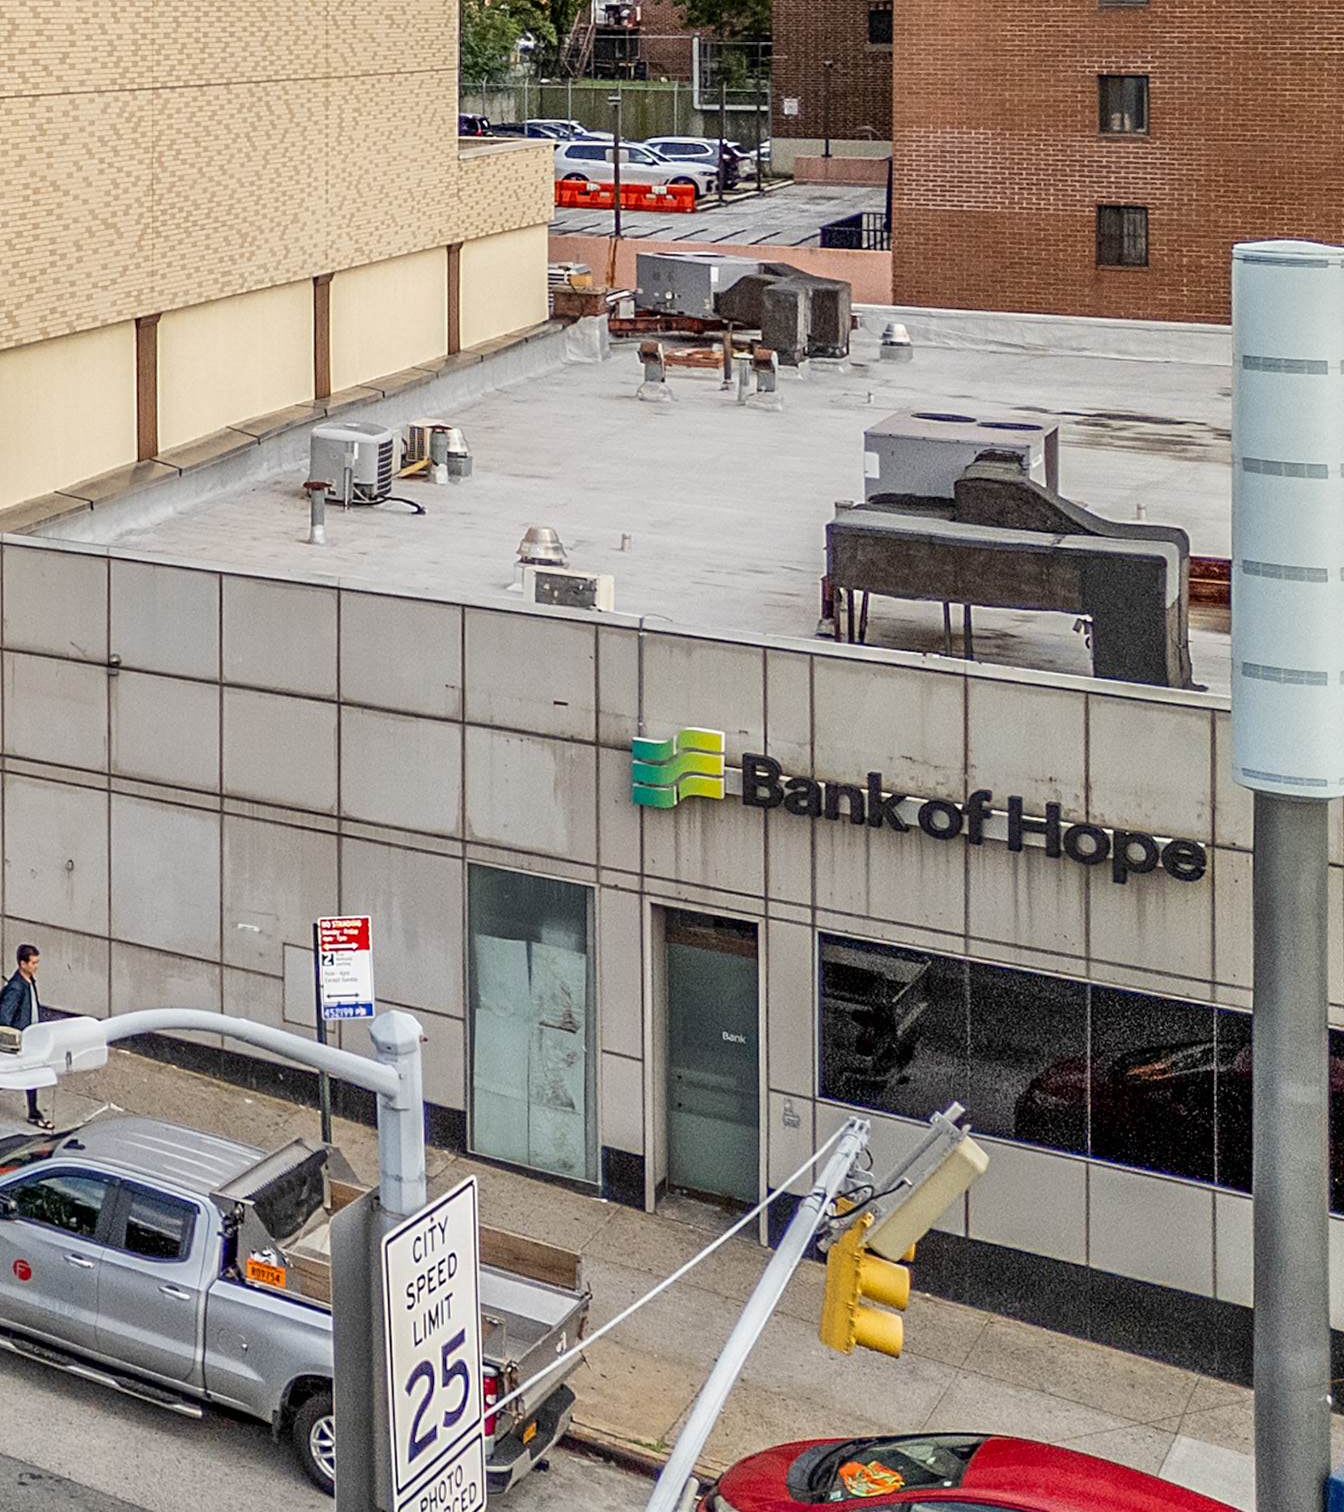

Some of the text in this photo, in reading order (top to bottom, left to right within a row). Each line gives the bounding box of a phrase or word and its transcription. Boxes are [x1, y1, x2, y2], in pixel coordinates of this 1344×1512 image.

[742, 752, 1208, 885] Bank of Hope
[322, 954, 334, 966] 2
[722, 1031, 746, 1044] Bank
[412, 1215, 448, 1264] CITY
[406, 1251, 458, 1311] SPEED
[413, 1291, 453, 1348] LIMIT
[404, 1328, 470, 1464] 25
[420, 1464, 463, 1512] PHOTO
